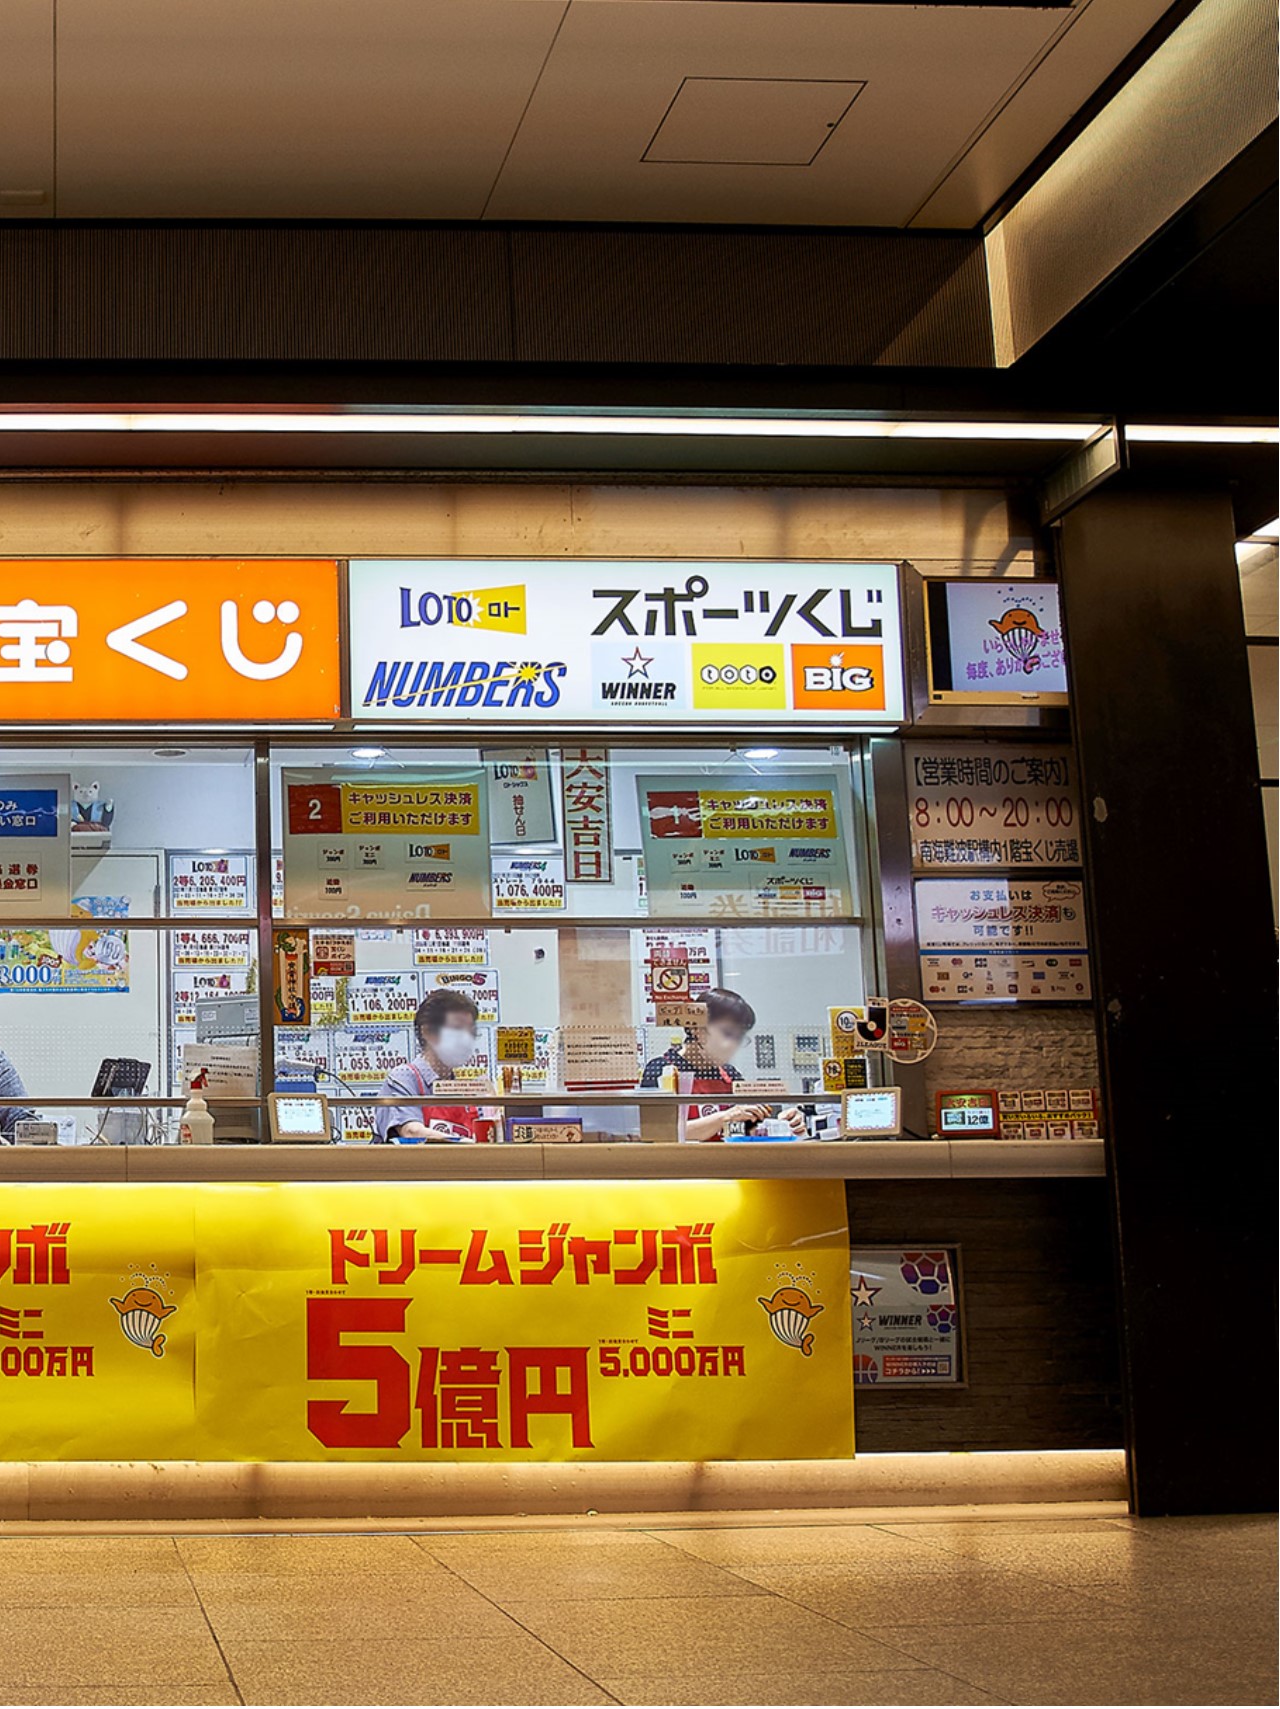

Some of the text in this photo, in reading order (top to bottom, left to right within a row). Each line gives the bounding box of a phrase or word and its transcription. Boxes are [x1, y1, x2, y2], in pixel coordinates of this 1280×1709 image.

[400, 586, 520, 629] LOTO ロト
[590, 575, 882, 637] スポーツくじ
[701, 664, 776, 685] toto
[803, 655, 874, 692] BIG
[363, 661, 567, 708] NUMBERS
[600, 682, 676, 701] WINNER
[914, 757, 1069, 787] 【営業時間のご案内】
[348, 791, 472, 806] キャッシュレス決済
[308, 800, 322, 820] 2
[348, 811, 472, 827] ご利用いただけます
[566, 750, 605, 879] 大安吉日
[709, 817, 830, 831] ご利用いただけます
[409, 844, 433, 857] LOTO
[735, 848, 758, 861] LOTO
[788, 848, 831, 858] NUMBERS
[409, 872, 453, 883] NUMBERS
[766, 876, 814, 885] スポーツくじ
[970, 890, 1033, 901] お支払いは
[931, 905, 1076, 923] キャッシュレス決済も
[973, 925, 1034, 937] 可能です!!
[328, 1222, 718, 1286] ドリームジャンボ
[0, 1306, 44, 1339] ミニ
[647, 1306, 694, 1339] ミニ
[878, 1315, 922, 1327] WINNER
[306, 1297, 595, 1449] 5億円
